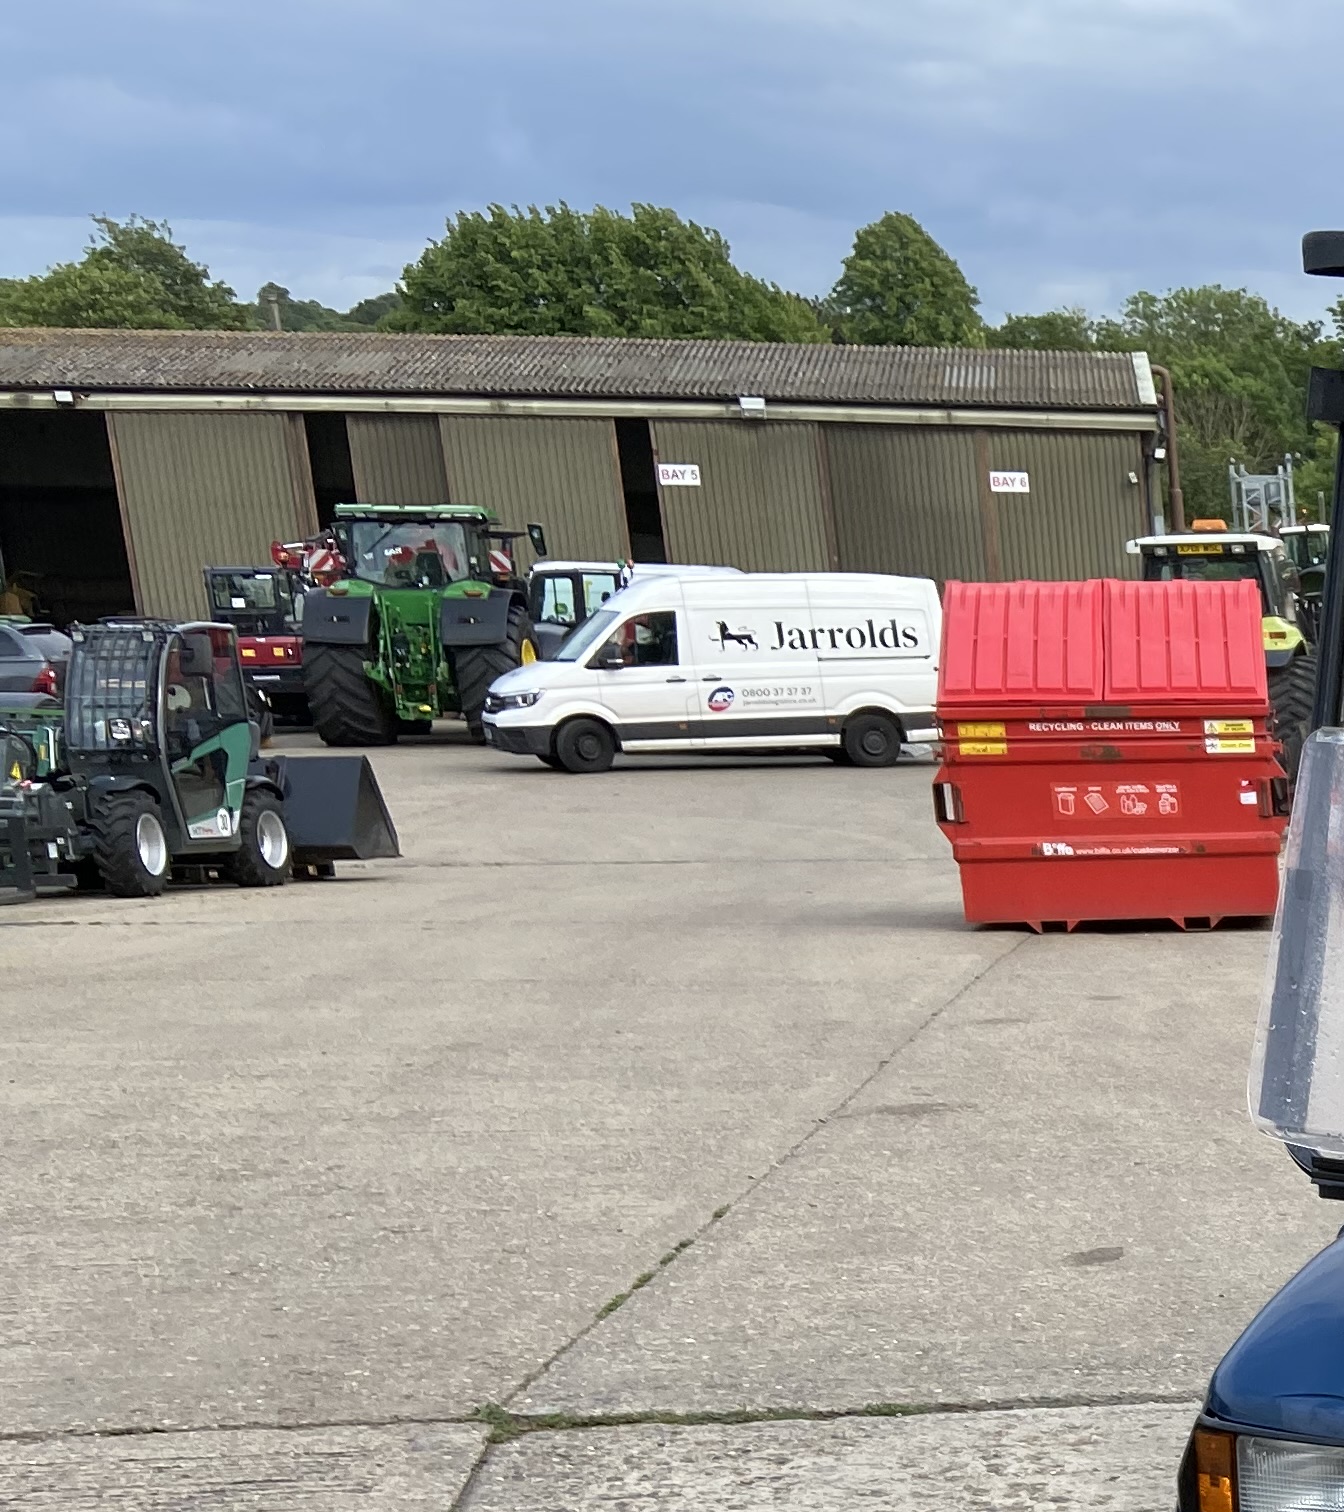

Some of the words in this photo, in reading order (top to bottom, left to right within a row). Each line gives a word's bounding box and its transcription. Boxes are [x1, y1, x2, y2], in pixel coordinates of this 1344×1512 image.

[660, 468, 686, 480] BAY
[690, 469, 698, 480] 5
[992, 476, 1017, 487] BAY
[1019, 476, 1028, 488] 6
[770, 618, 919, 651] Jarrolds
[742, 688, 771, 698] 0800
[773, 688, 784, 697] 37
[787, 687, 798, 696] 37
[801, 687, 812, 695] 37
[1028, 722, 1084, 731] RECYCLING
[1091, 722, 1125, 731] CLEAN
[1125, 722, 1154, 730] ITEMS
[1155, 721, 1180, 731] ONLY
[1042, 842, 1074, 856] Biffa
